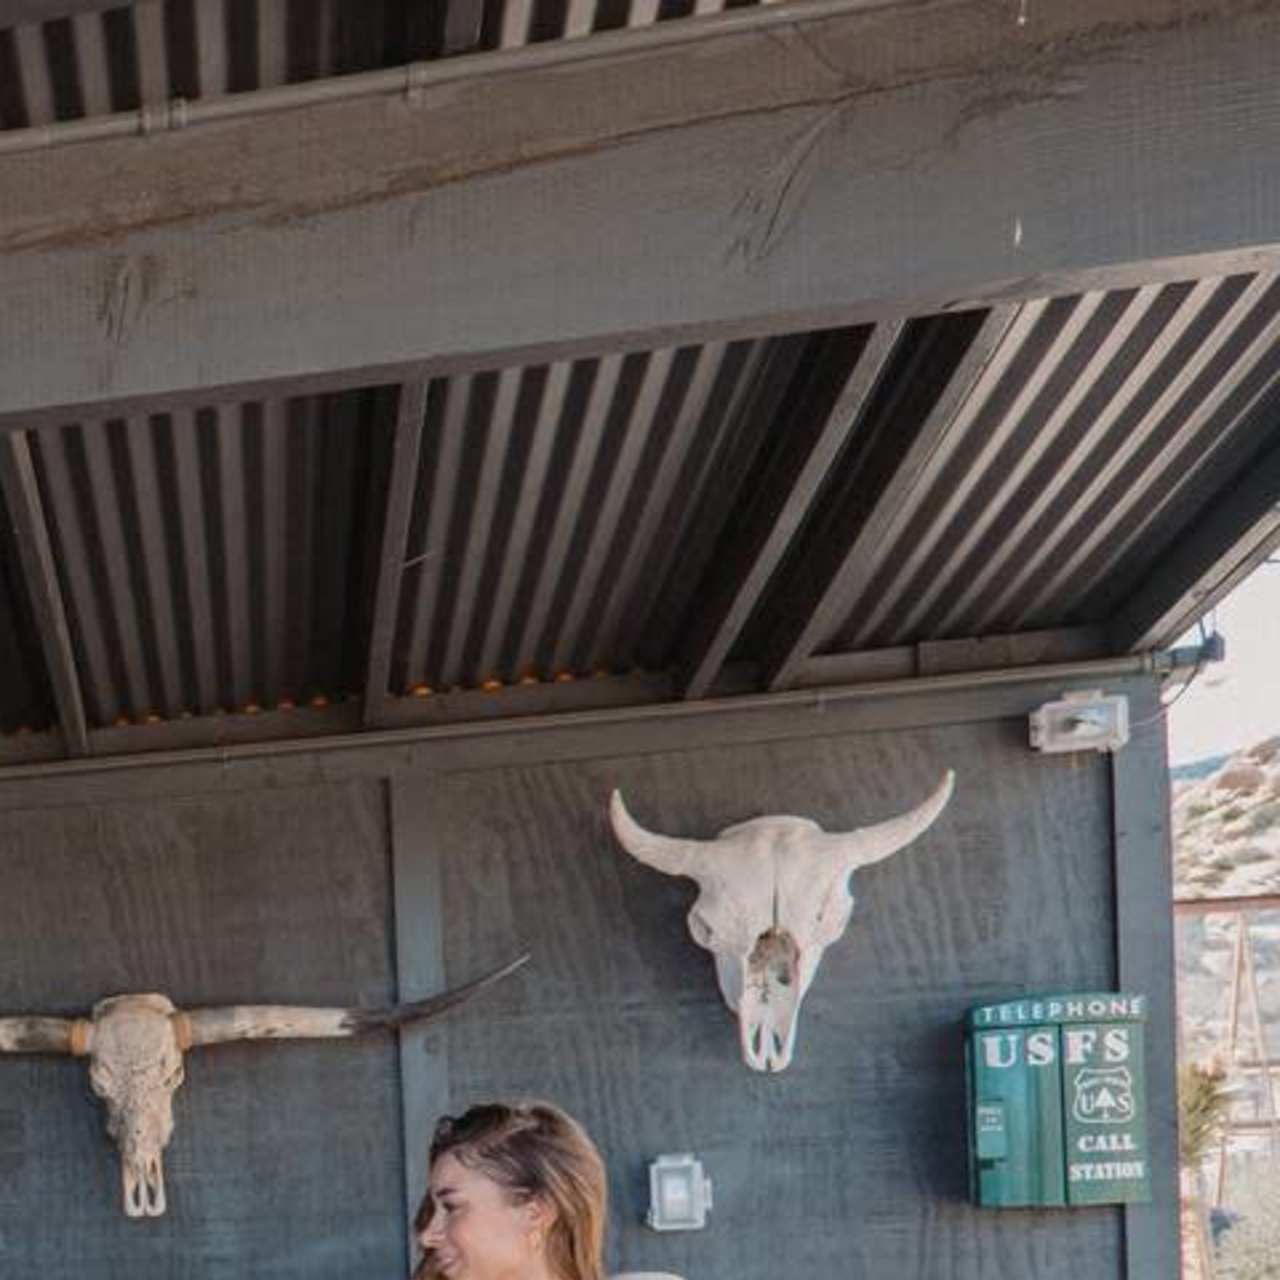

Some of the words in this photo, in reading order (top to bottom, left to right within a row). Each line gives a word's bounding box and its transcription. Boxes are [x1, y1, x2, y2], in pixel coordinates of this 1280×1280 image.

[983, 998, 1144, 1023] TELEPHONE
[983, 1029, 1129, 1068] USFS
[1078, 1132, 1137, 1152] CALL
[1068, 1161, 1145, 1182] STATION
